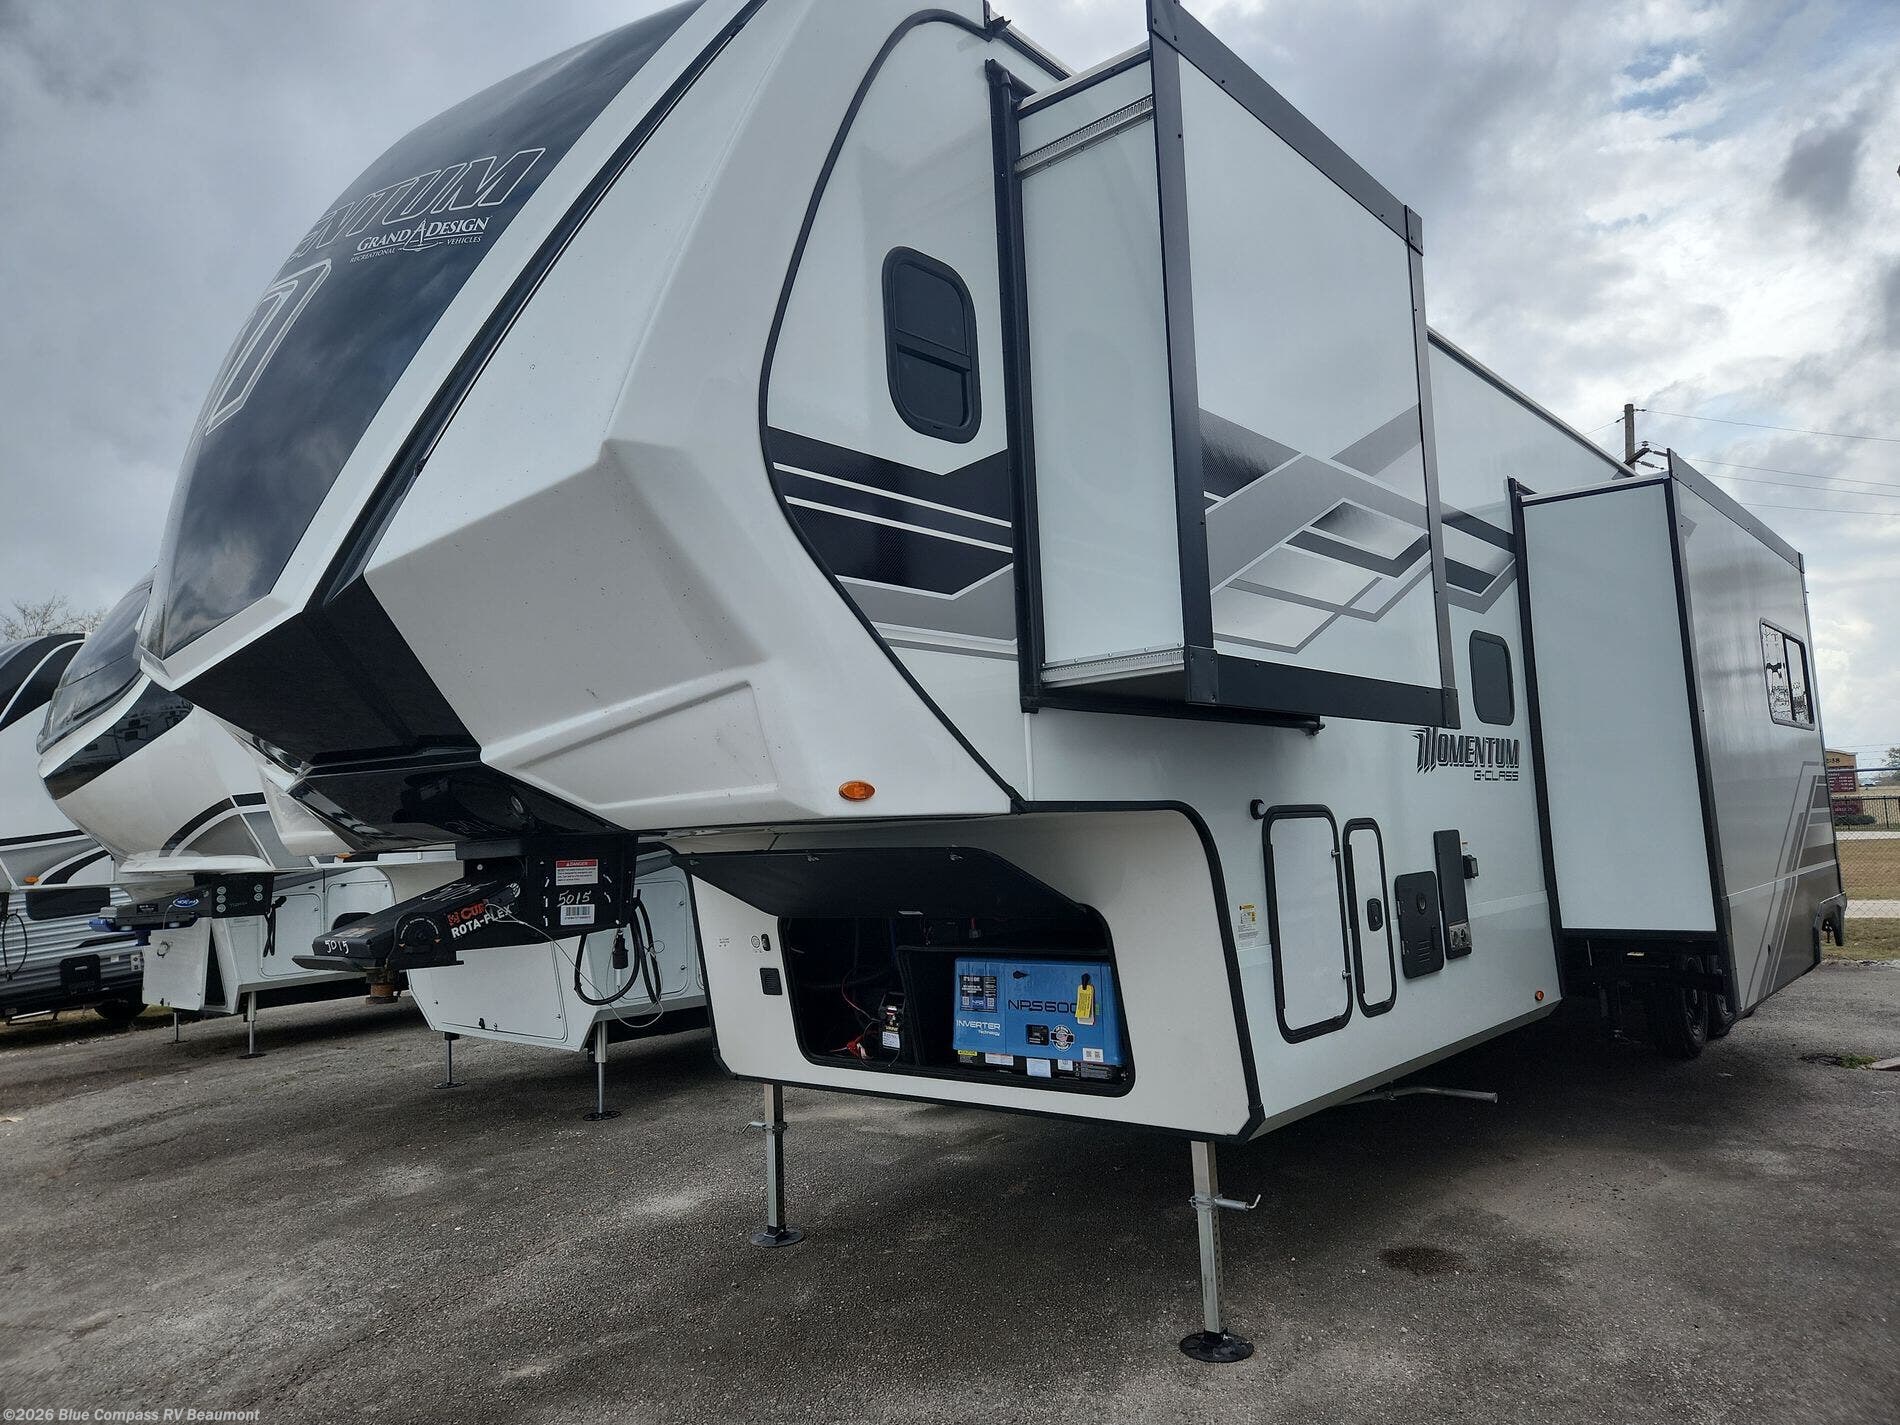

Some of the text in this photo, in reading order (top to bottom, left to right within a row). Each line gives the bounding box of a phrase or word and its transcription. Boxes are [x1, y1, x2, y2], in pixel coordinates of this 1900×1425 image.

[356, 217, 489, 252] GRAND DESIGN
[447, 236, 482, 246] VEHICLES
[1409, 727, 1520, 774] MOMENTUM
[557, 890, 592, 908] 5015
[451, 905, 512, 938] ROTA-FLEX
[325, 940, 350, 954] 5015
[956, 1020, 1001, 1031] INVERTER
